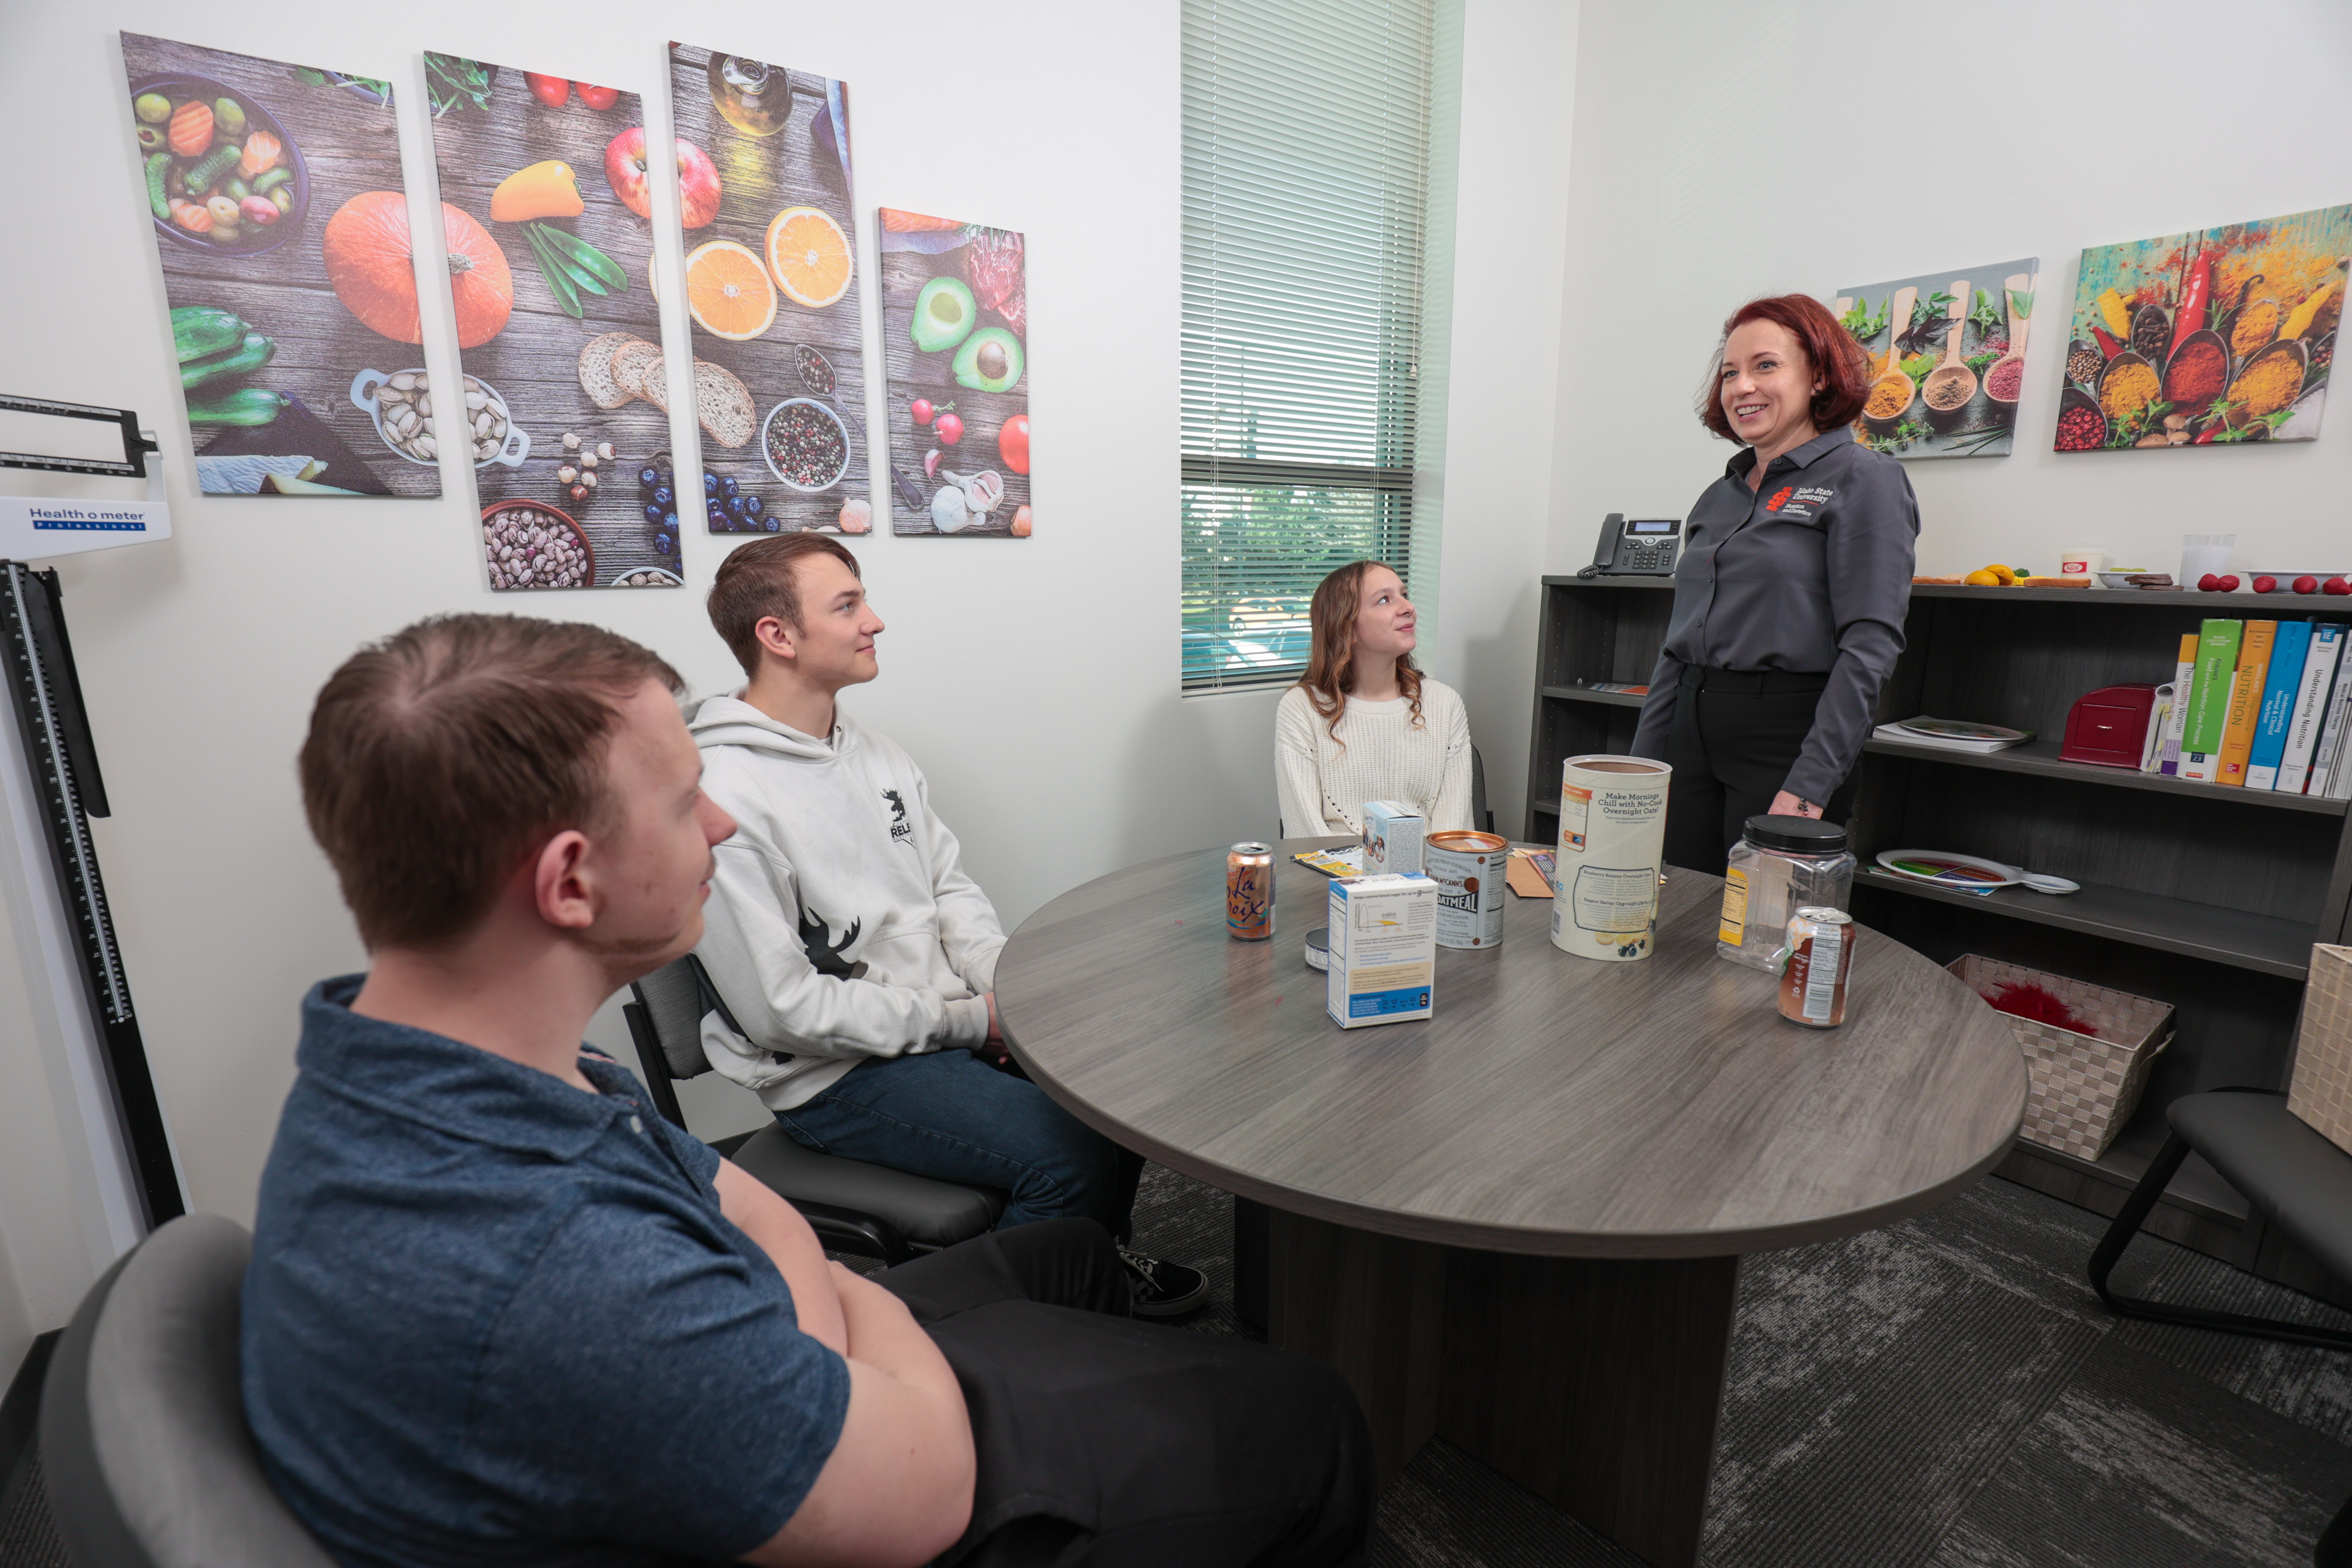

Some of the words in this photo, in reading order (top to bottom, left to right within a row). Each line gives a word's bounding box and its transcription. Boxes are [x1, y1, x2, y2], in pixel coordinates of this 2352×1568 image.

[1793, 493, 1828, 504] University
[1814, 487, 1833, 496] State
[30, 508, 84, 519] Health
[2322, 632, 2333, 640] IE
[2206, 657, 2215, 671] Food
[2213, 658, 2222, 680] Krause's
[2184, 667, 2195, 679] The
[2252, 662, 2264, 693] WARDLAW'S
[2178, 681, 2191, 706] Healthy
[2231, 665, 2253, 725] NUTRITION
[2303, 669, 2323, 717] Understanding
[2340, 683, 2349, 698] Medical
[2200, 688, 2210, 710] Nutrition
[2273, 690, 2284, 710] Normal
[2335, 699, 2344, 714] Nutrition
[2175, 707, 2187, 733] Woman
[2197, 711, 2206, 724] Care
[2262, 700, 2274, 724] Nutrition
[2275, 694, 2291, 733] Understanding
[2267, 715, 2278, 735] Clinical
[2331, 715, 2341, 730] Therapy
[2193, 724, 2203, 745] Process
[2296, 719, 2311, 749] Nutrition
[1603, 807, 1642, 816] Overnight
[1637, 799, 1663, 808] No-Cook
[1432, 865, 1448, 873] CHICAGO,
[1451, 862, 1472, 874] EXHIBITION
[1966, 870, 1994, 878] Grains
[1232, 866, 1256, 900] La
[1438, 894, 1477, 912] OATMEAL
